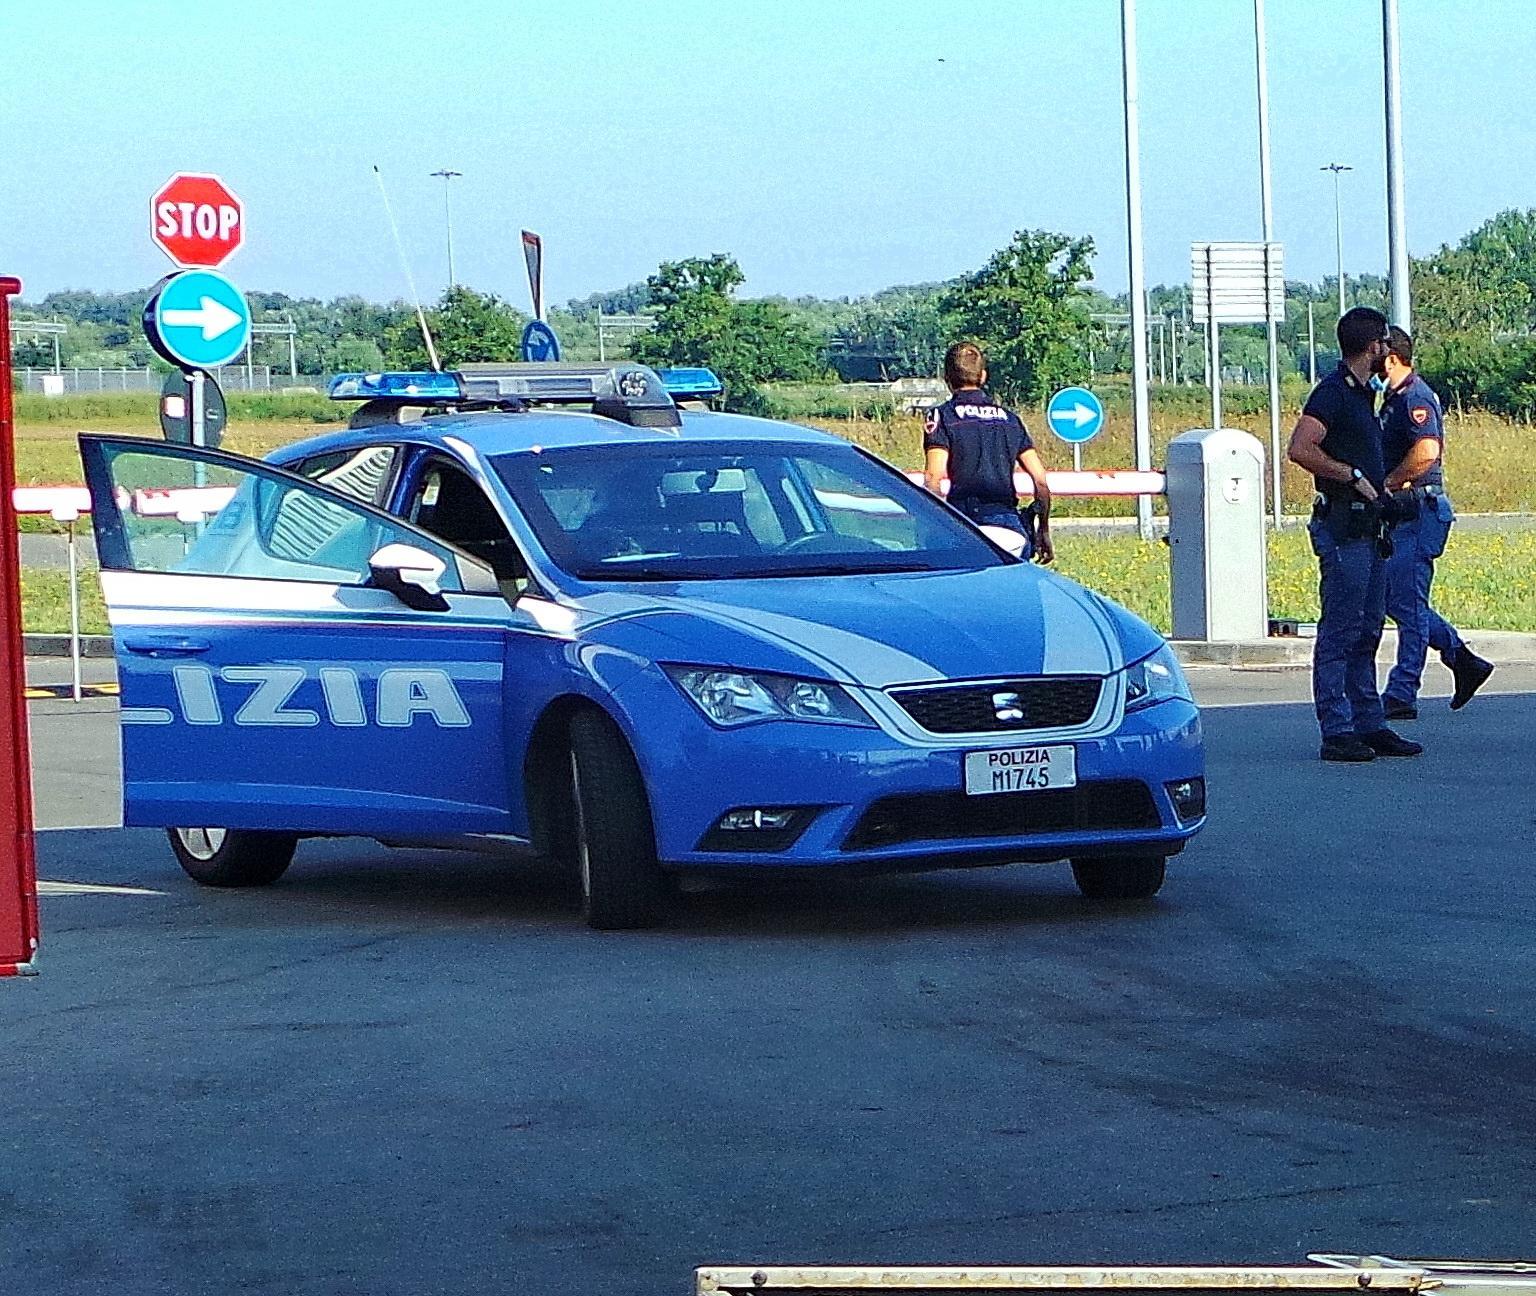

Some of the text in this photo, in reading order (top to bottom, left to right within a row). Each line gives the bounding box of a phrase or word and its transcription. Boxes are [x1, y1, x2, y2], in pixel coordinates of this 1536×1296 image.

[157, 200, 239, 241] STOP
[954, 403, 1009, 421] POLIZIA
[988, 748, 1051, 767] POLIZIA
[991, 766, 1050, 791] M1745
